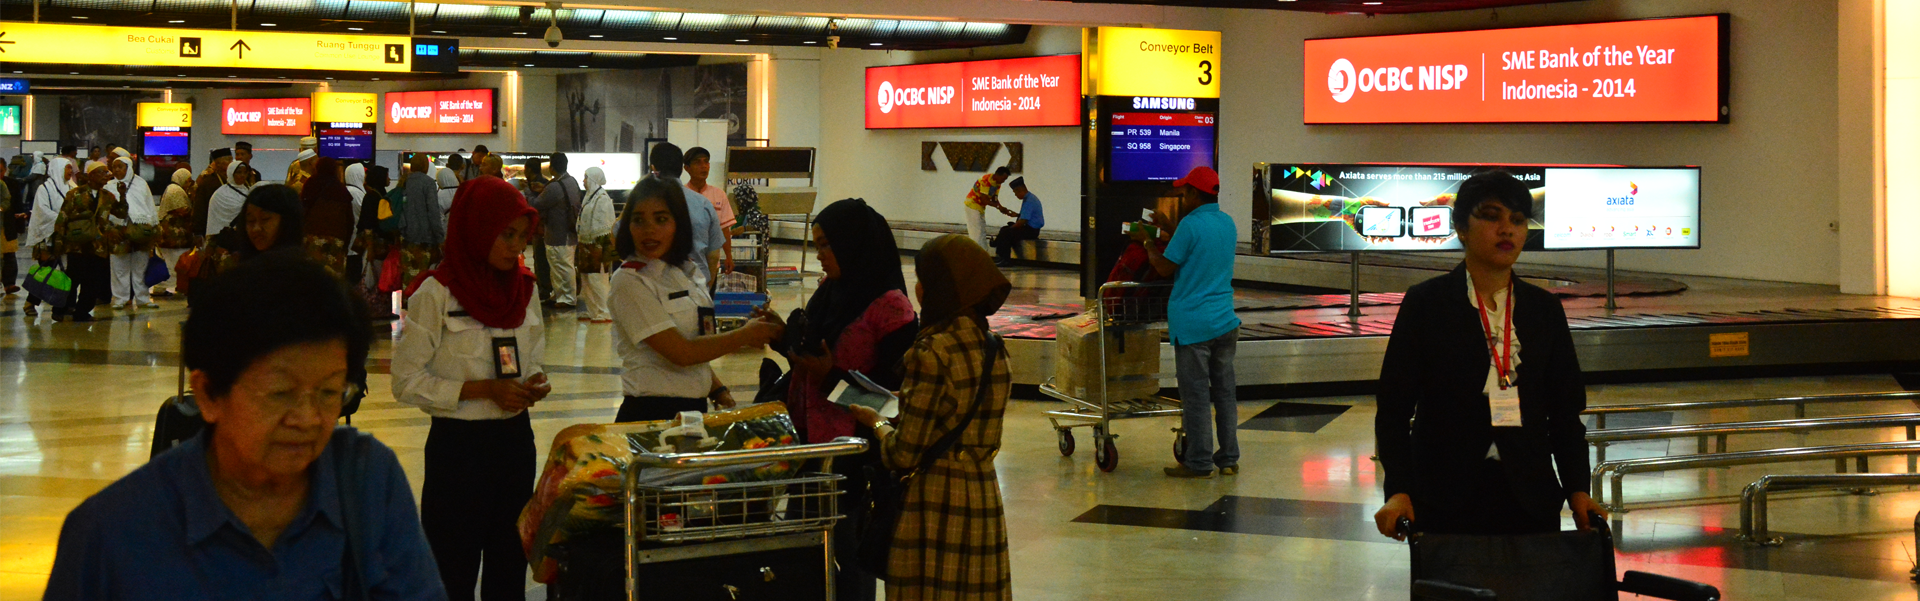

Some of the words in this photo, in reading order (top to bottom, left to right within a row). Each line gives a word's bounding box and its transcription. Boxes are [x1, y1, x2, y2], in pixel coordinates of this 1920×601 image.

[127, 34, 145, 43] Bea
[148, 35, 174, 43] Cukai
[316, 40, 345, 50] Ruang
[348, 41, 380, 51] Tunggu
[1139, 40, 1190, 56] Conveyor
[1193, 43, 1213, 54] Belt
[1502, 50, 1535, 71] SME
[1539, 47, 1579, 69] Bank
[1582, 45, 1602, 67] of
[1603, 45, 1633, 66] the
[1636, 45, 1675, 65] Year
[1197, 60, 1213, 86] 3
[1358, 66, 1414, 93] OCBC
[1418, 64, 1468, 91] NISP
[971, 77, 990, 91] SME
[991, 75, 1012, 90] Bank
[1013, 74, 1023, 89] of
[1024, 74, 1039, 88] the
[1040, 74, 1060, 88] Year
[1502, 78, 1578, 100] Indonesia
[1592, 78, 1636, 98] 2014
[894, 87, 926, 106] OCBC
[927, 86, 955, 105] NISP
[971, 97, 1012, 111] Indonesia
[1018, 96, 1041, 111] 2014
[1132, 97, 1195, 110] SAMSUNG
[365, 106, 373, 117] 3
[181, 113, 189, 122] 2
[1204, 116, 1214, 124] 03
[1127, 128, 1138, 136] PR
[1127, 142, 1138, 150] SQ
[1139, 142, 1152, 150] 958
[1159, 142, 1191, 152] Singapore
[1339, 171, 1365, 180] Axiata
[1366, 172, 1392, 180] serves
[1393, 173, 1416, 181] more
[1447, 172, 1472, 181] million
[1524, 173, 1541, 181] Asia
[1606, 195, 1635, 206] axiata
